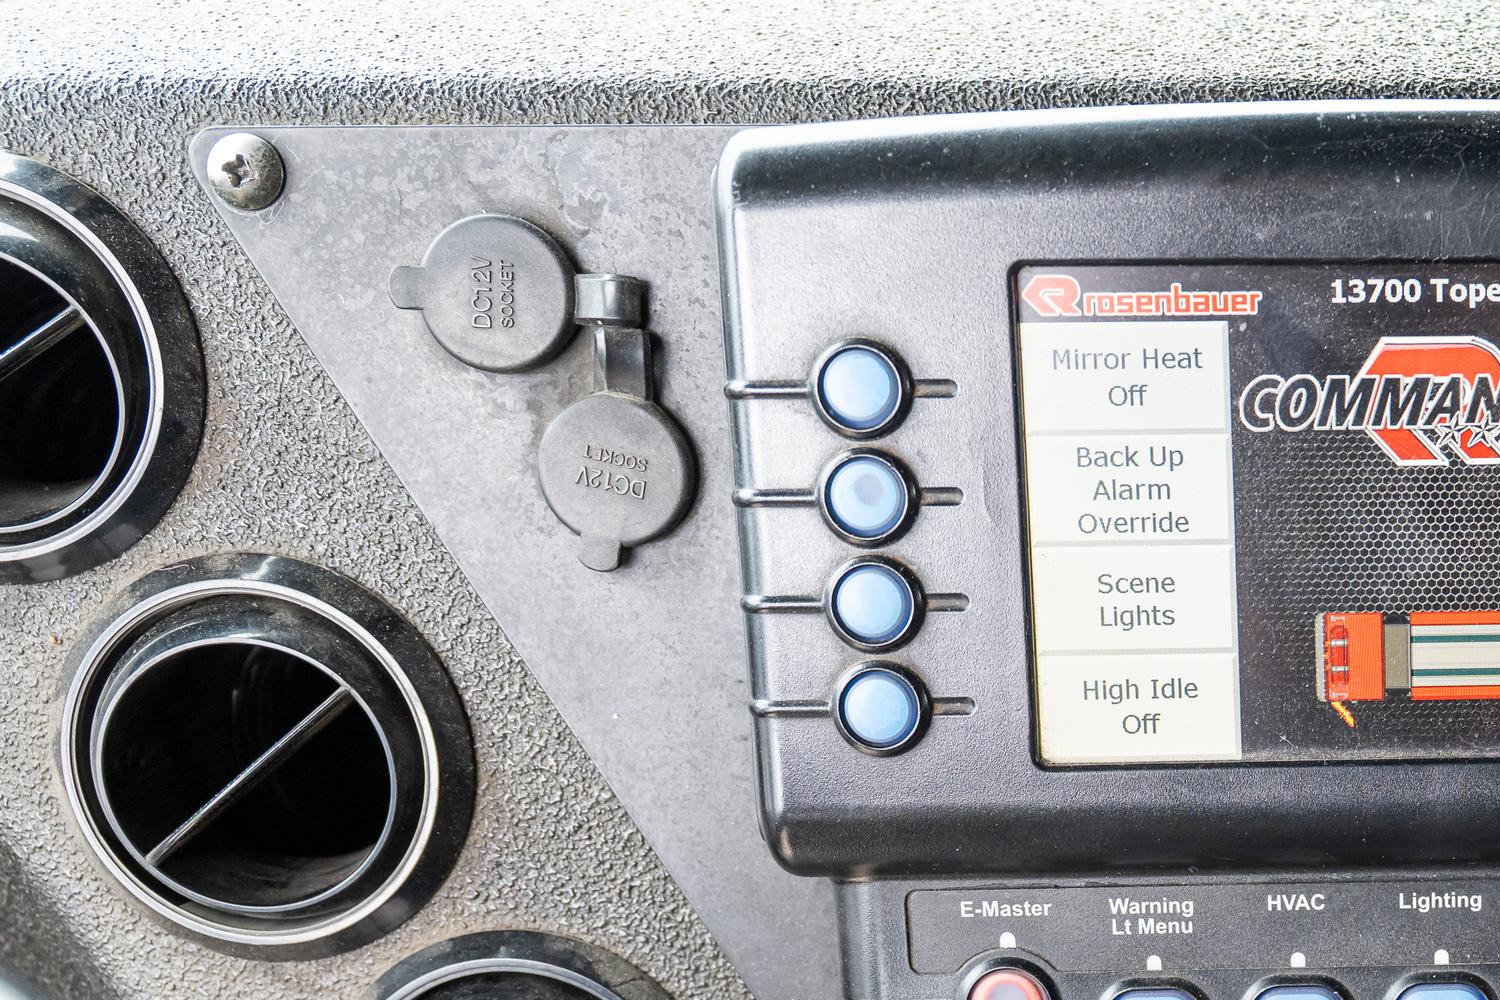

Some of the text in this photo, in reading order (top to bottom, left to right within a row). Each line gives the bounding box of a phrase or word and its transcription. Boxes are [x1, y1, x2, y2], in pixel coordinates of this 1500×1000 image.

[472, 255, 493, 330] DC12V
[500, 259, 515, 329] SOCKET
[1083, 283, 1263, 317] rosenbauer
[1331, 278, 1422, 303] 13700
[1052, 347, 1204, 371] Mirror Heat
[1108, 384, 1149, 407] Off
[582, 443, 649, 472] SOCKET
[1076, 445, 1185, 476] Back Up
[575, 464, 647, 500] DC12V
[1093, 478, 1172, 502] Alarm
[1077, 511, 1190, 535] Override
[1096, 572, 1176, 595] Scene
[1099, 604, 1176, 631] Lights
[1082, 676, 1199, 706] High Idle
[1122, 712, 1161, 736] Off
[959, 901, 1053, 918] E-Master
[1108, 897, 1195, 918] Warning
[1266, 893, 1326, 912] HVAC
[1399, 892, 1483, 912] Lighting
[1111, 917, 1194, 936] Lt Menu
